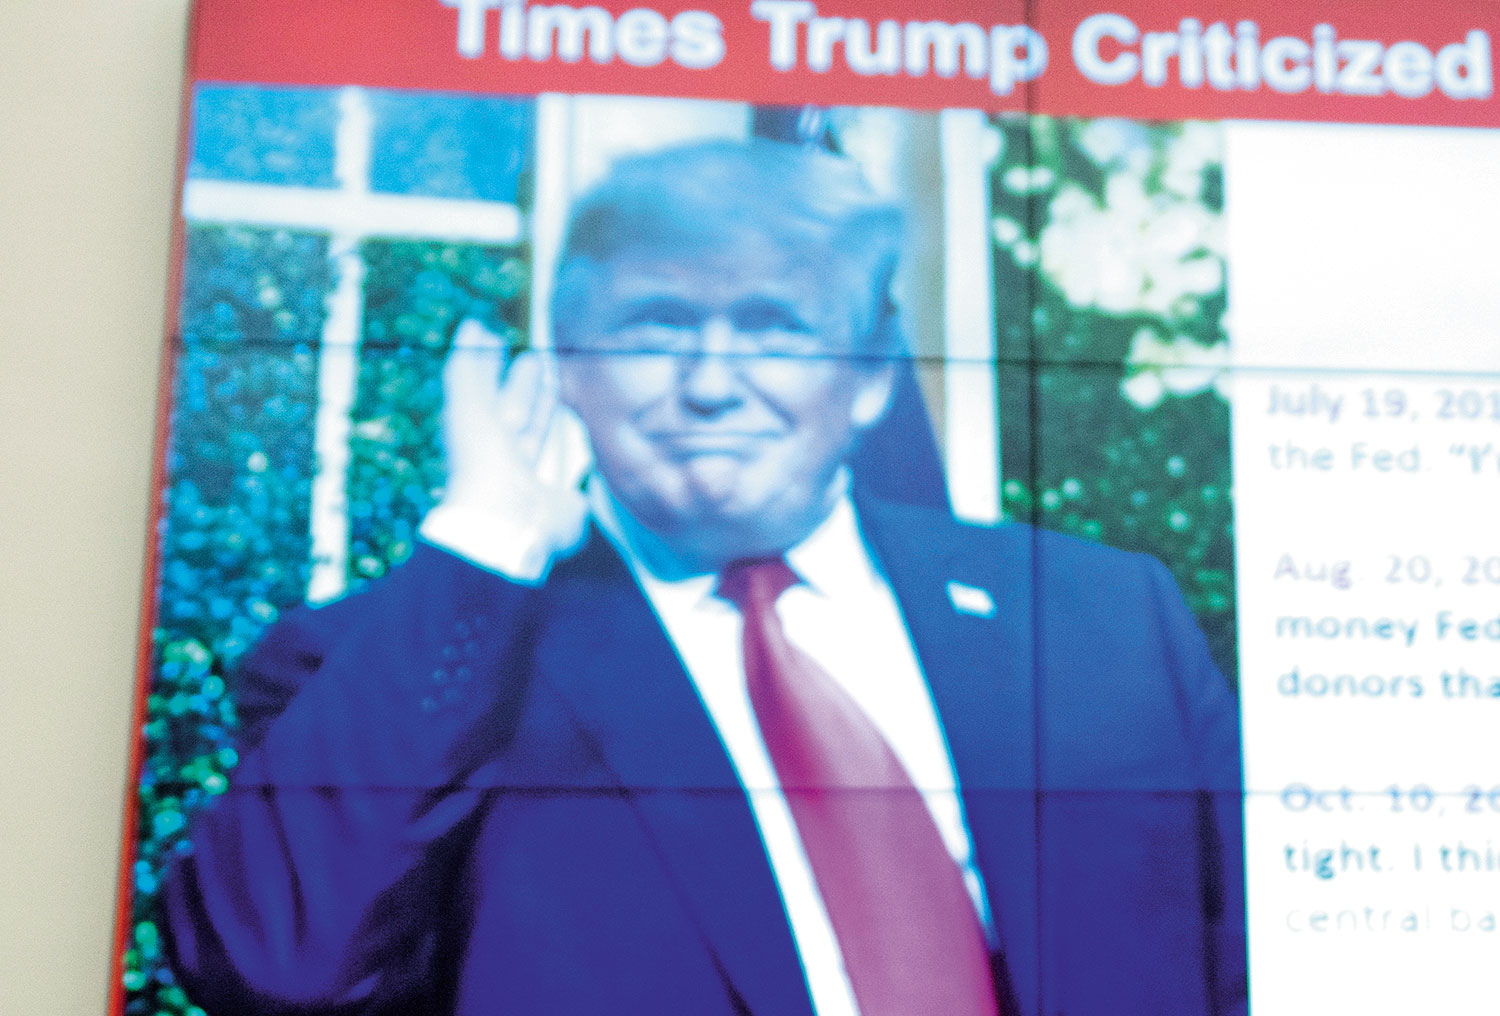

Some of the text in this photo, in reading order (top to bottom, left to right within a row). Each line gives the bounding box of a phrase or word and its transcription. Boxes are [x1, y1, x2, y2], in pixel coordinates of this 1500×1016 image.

[441, 0, 726, 69] Times
[752, 0, 1047, 96] Trump
[1069, 12, 1495, 101] Criticized
[1266, 386, 1343, 422] July
[1361, 389, 1419, 422] 19,
[1267, 442, 1335, 471] the
[1384, 554, 1442, 587] 20,
[1275, 614, 1419, 647] money
[1276, 667, 1424, 699] donors
[1389, 784, 1445, 816] 10,
[1283, 843, 1395, 880] tight.
[1413, 843, 1422, 872] I
[1284, 903, 1432, 934] central
